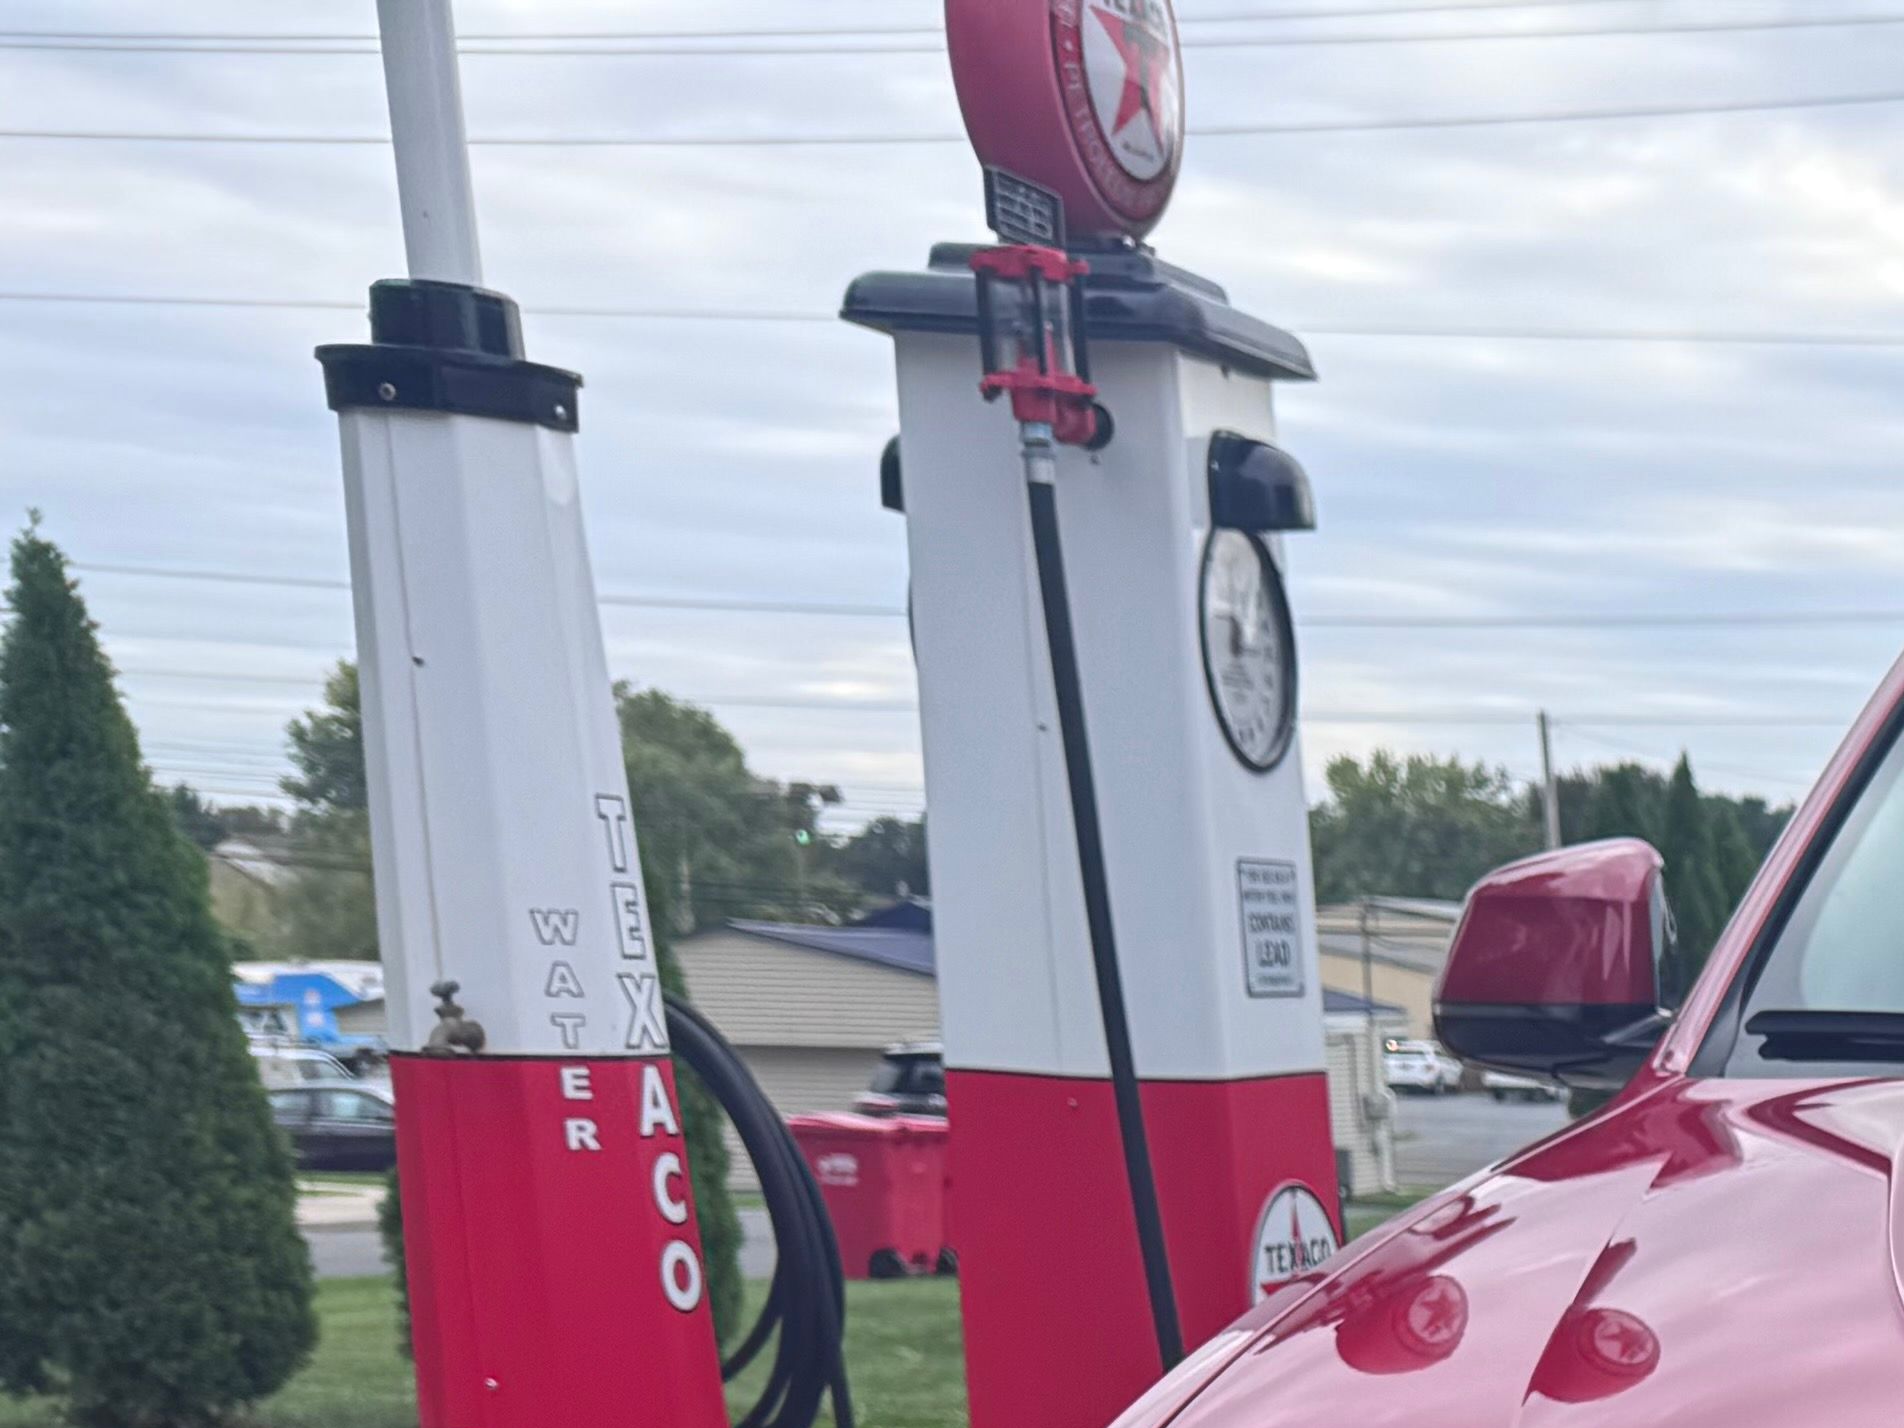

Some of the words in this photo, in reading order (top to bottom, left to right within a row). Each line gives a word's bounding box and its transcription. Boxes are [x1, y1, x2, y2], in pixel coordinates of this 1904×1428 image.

[1256, 938, 1291, 968] LEAD
[530, 907, 602, 1152] WATER
[595, 794, 702, 1312] TEXACO
[1264, 1237, 1332, 1274] TEXACO
